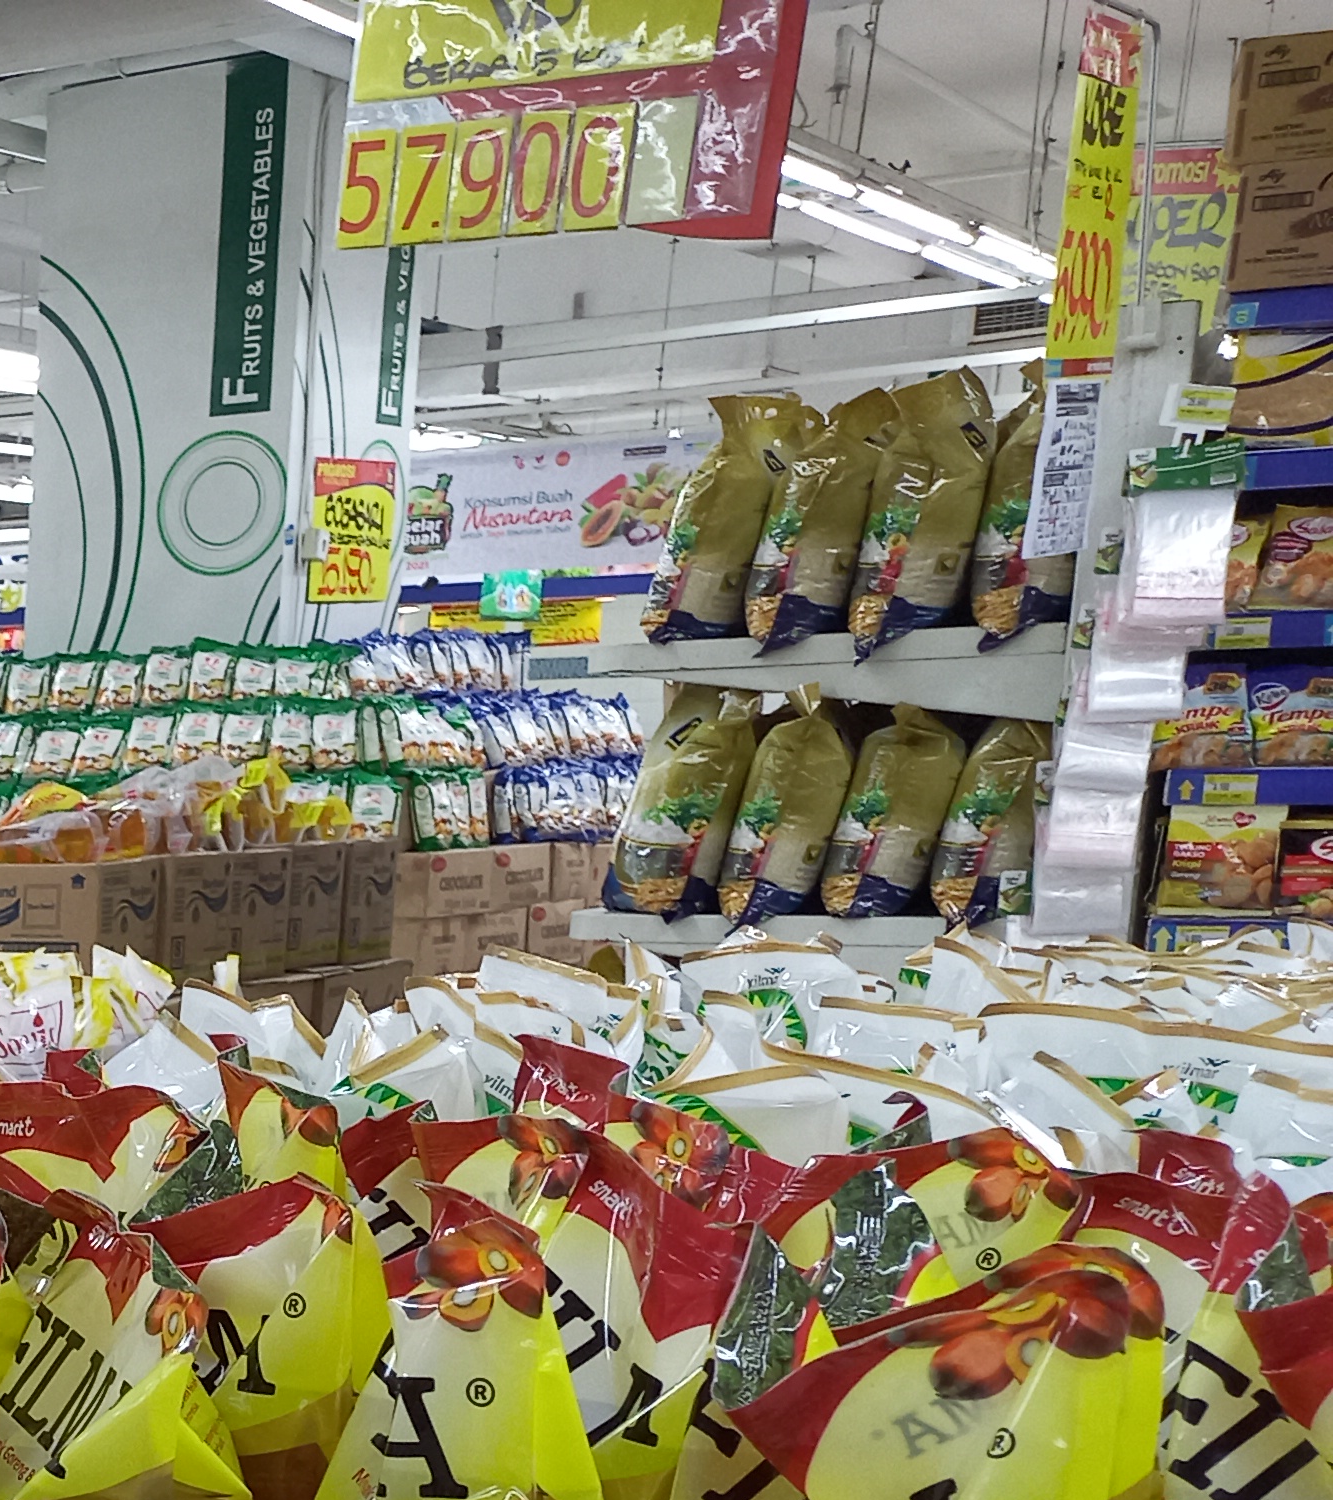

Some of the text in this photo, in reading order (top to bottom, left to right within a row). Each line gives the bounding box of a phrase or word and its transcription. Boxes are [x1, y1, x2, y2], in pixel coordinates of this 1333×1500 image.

[339, 116, 622, 234] 57.900
[223, 107, 275, 405] FRUITS & VEGETABLES
[381, 319, 403, 419] FRUITS
[462, 506, 573, 532] Nusantara
[464, 490, 573, 508] Konsumsi Buah
